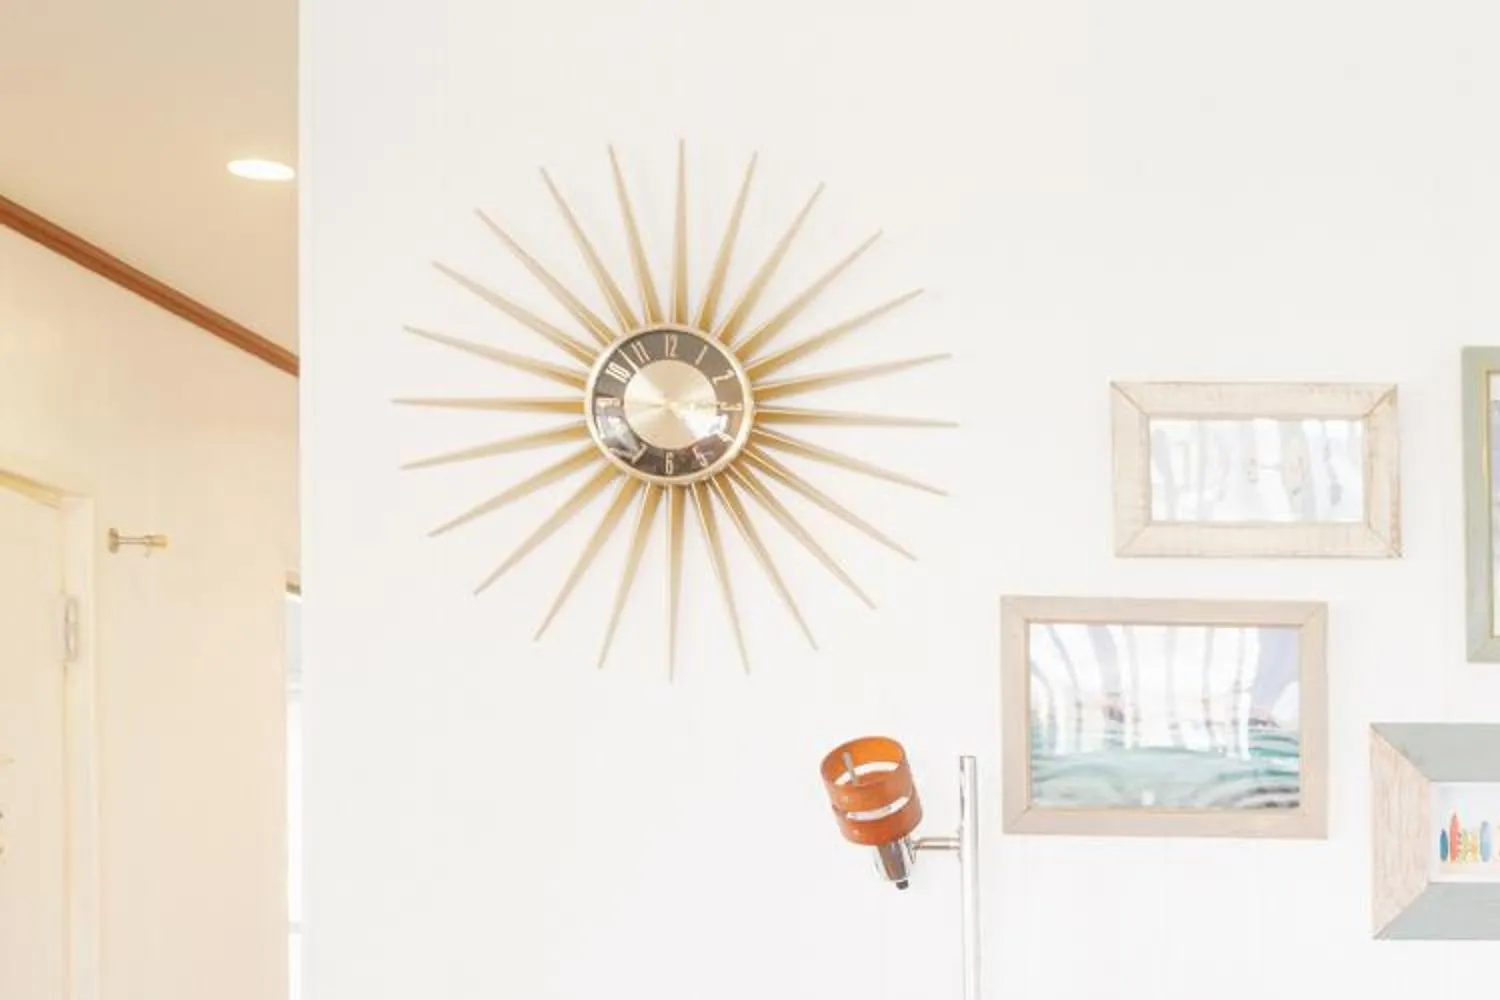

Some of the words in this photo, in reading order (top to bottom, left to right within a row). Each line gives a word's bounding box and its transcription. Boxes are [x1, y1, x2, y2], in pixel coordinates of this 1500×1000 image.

[631, 341, 650, 364] 11
[665, 334, 678, 357] 12
[695, 344, 709, 365] 1
[605, 361, 631, 384] 10
[665, 451, 674, 475] 6
